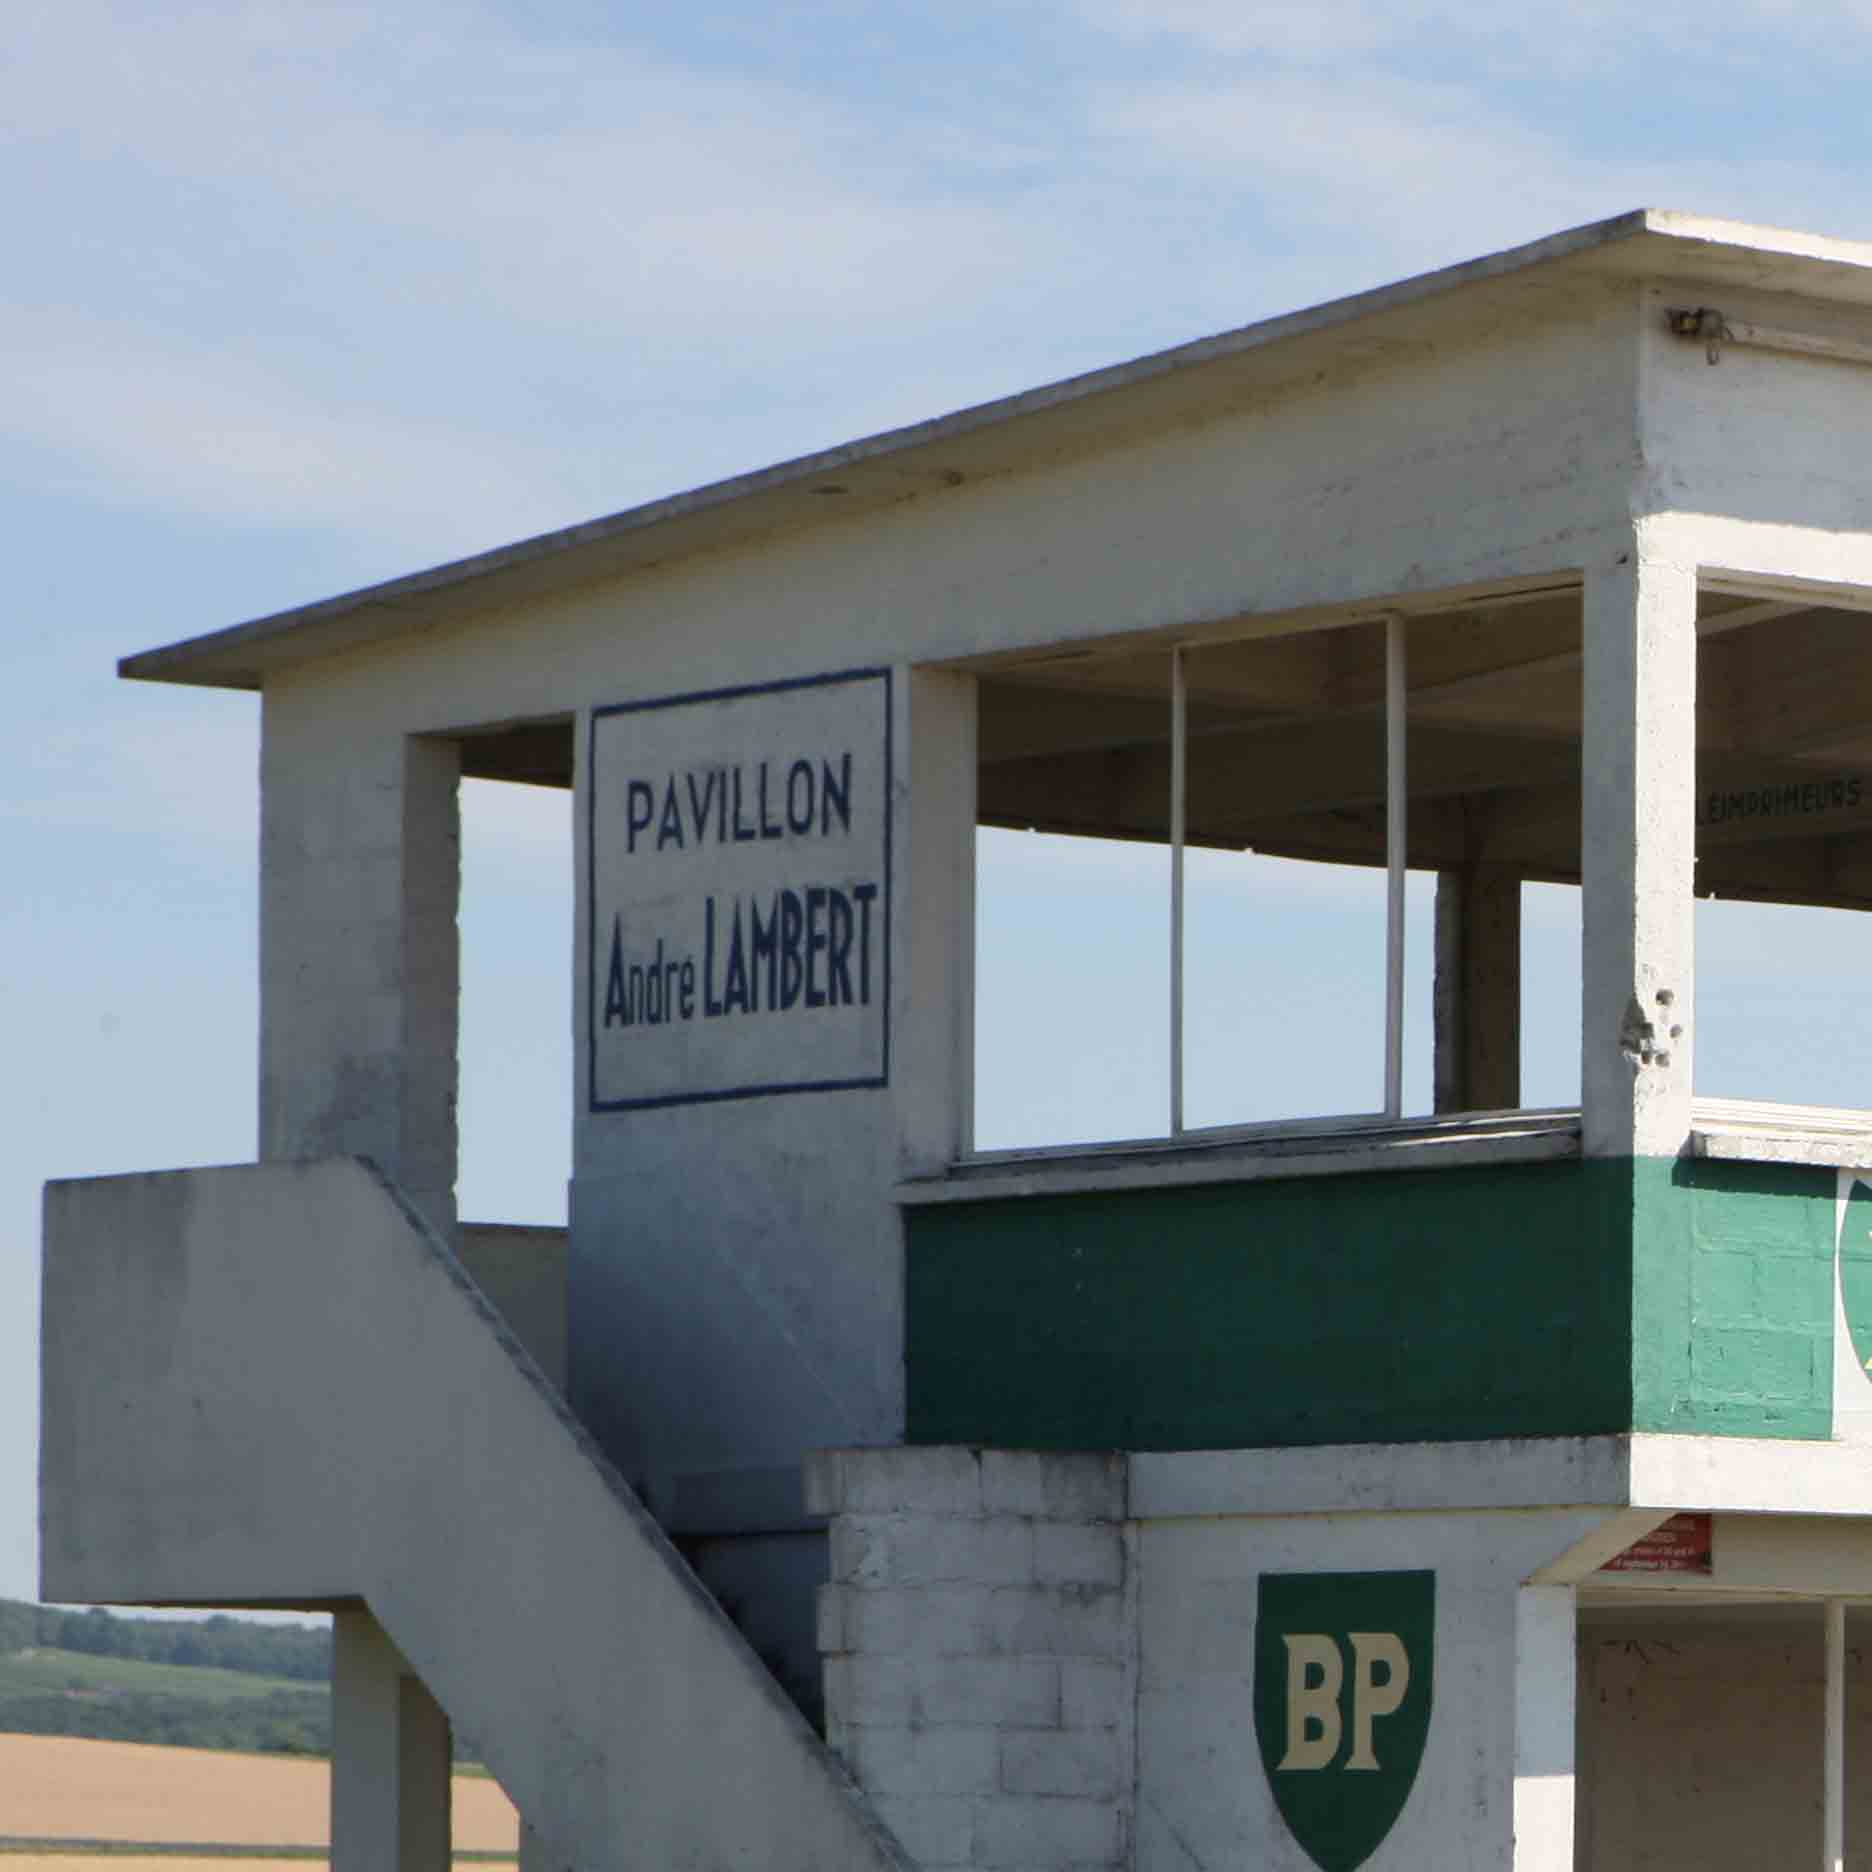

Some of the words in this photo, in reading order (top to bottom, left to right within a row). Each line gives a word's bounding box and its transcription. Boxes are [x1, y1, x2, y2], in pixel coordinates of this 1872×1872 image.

[626, 752, 852, 854] PAVILLON
[603, 911, 694, 1029] André
[702, 883, 878, 1018] LAMBERT
[1275, 1632, 1410, 1771] BP
